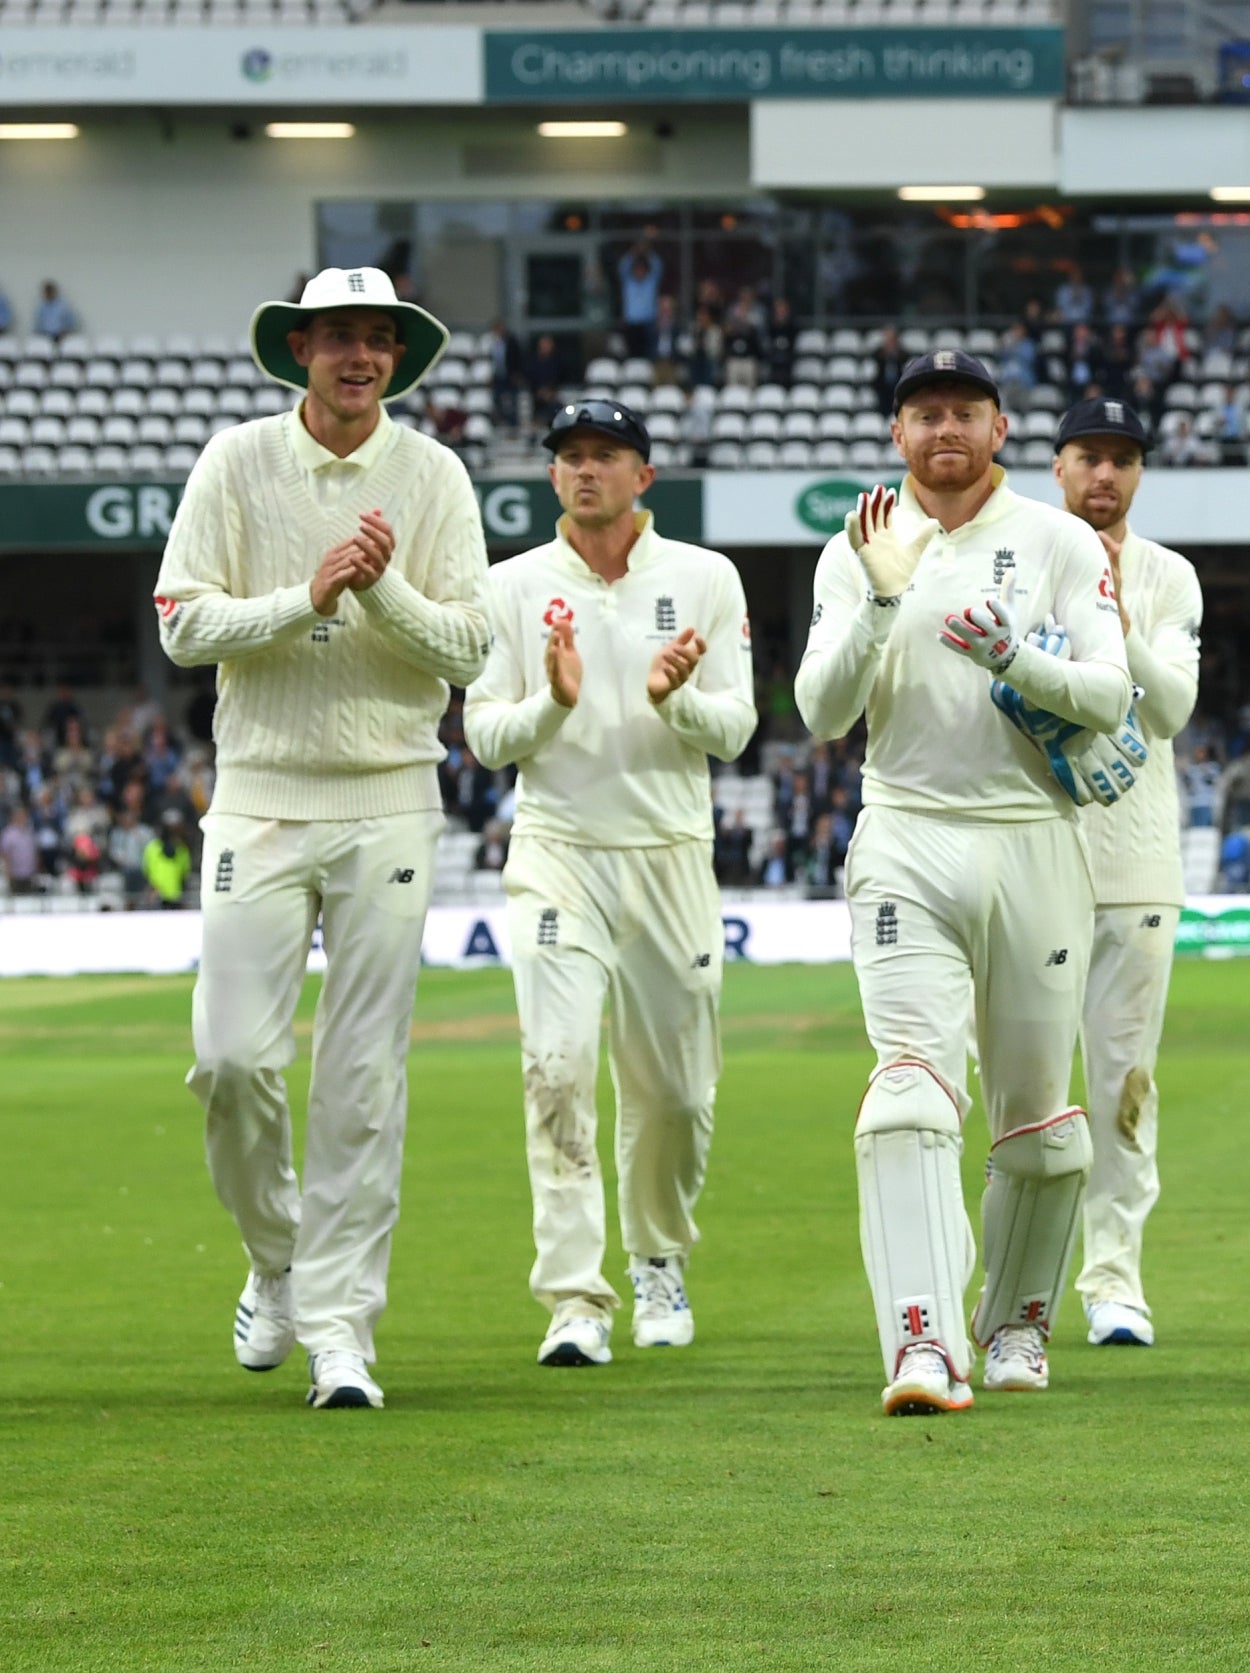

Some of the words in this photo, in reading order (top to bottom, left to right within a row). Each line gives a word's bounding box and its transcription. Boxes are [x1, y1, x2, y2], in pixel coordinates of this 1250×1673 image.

[510, 42, 773, 89] Championing
[779, 42, 875, 82] fresh
[882, 42, 1035, 89] thinking
